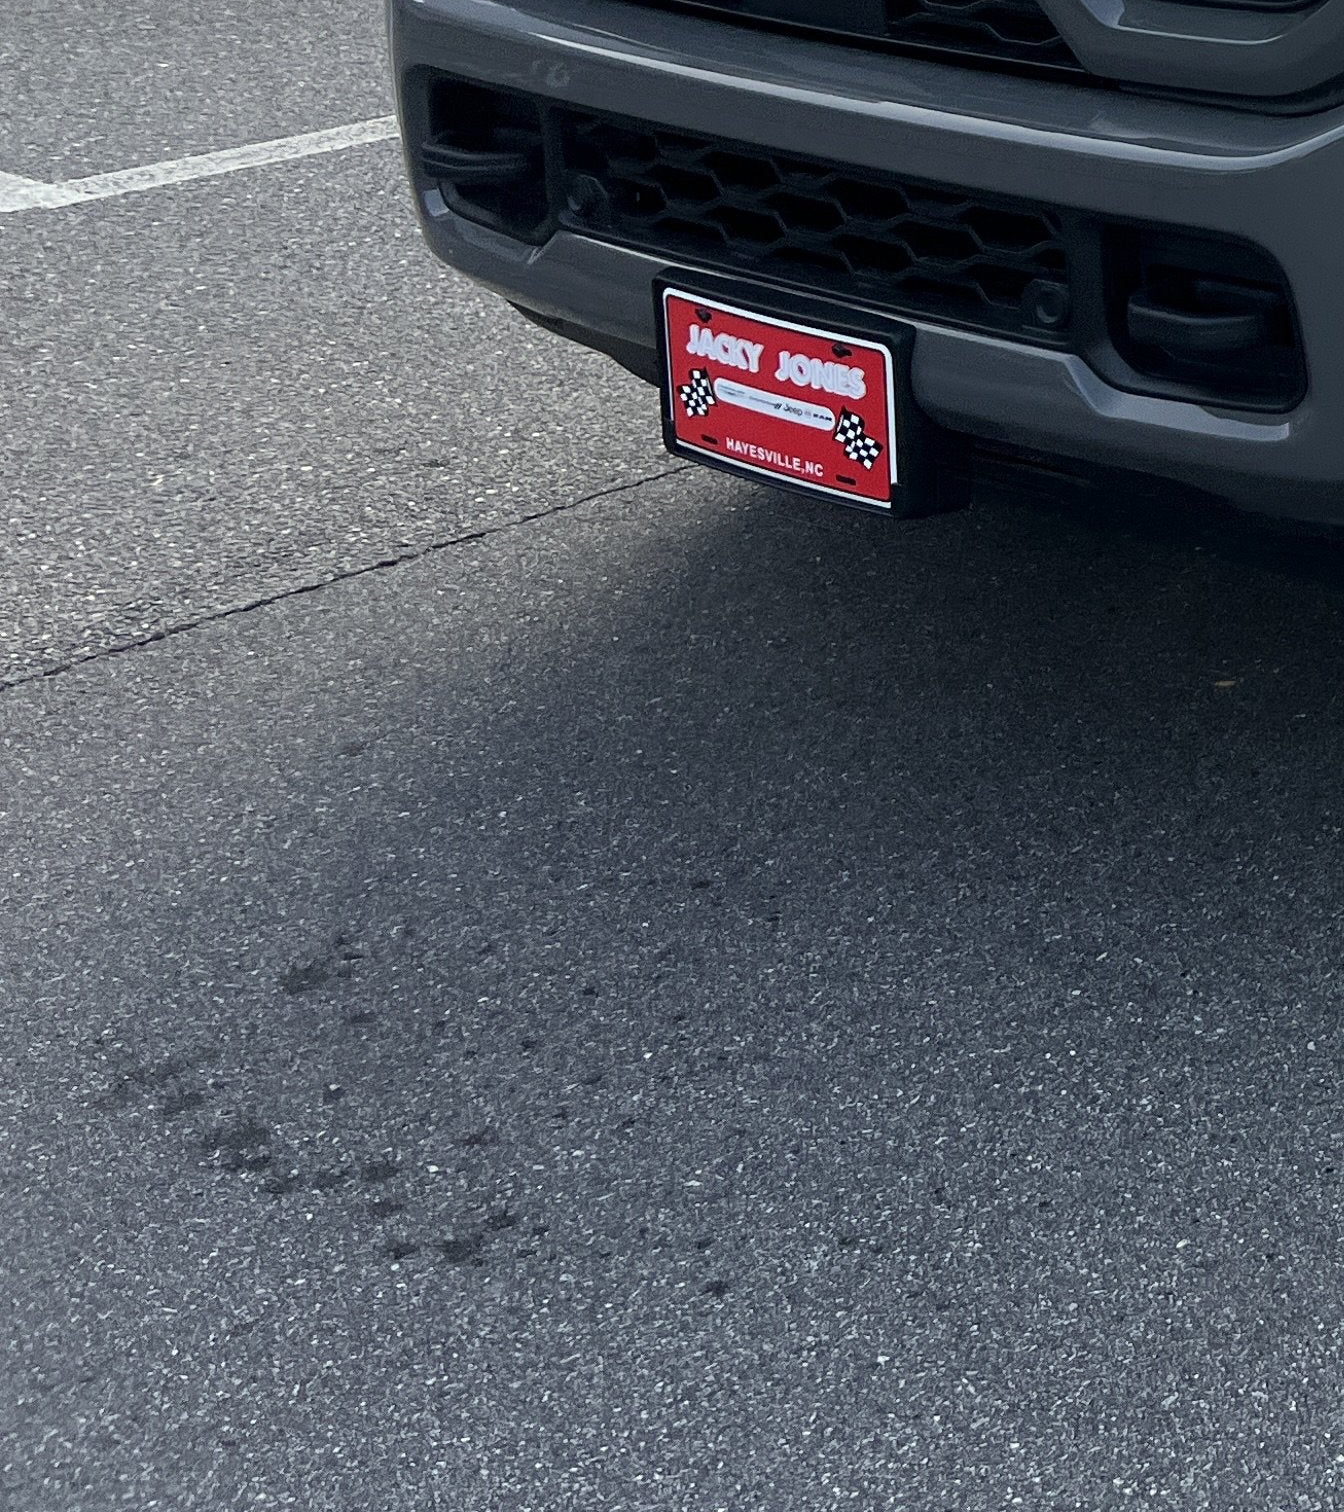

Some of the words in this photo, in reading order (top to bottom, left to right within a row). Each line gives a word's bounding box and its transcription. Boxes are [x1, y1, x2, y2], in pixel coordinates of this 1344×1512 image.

[686, 324, 765, 373] JACKY
[774, 351, 867, 400] JONES
[726, 436, 825, 477] HAYESVILLE,NC
